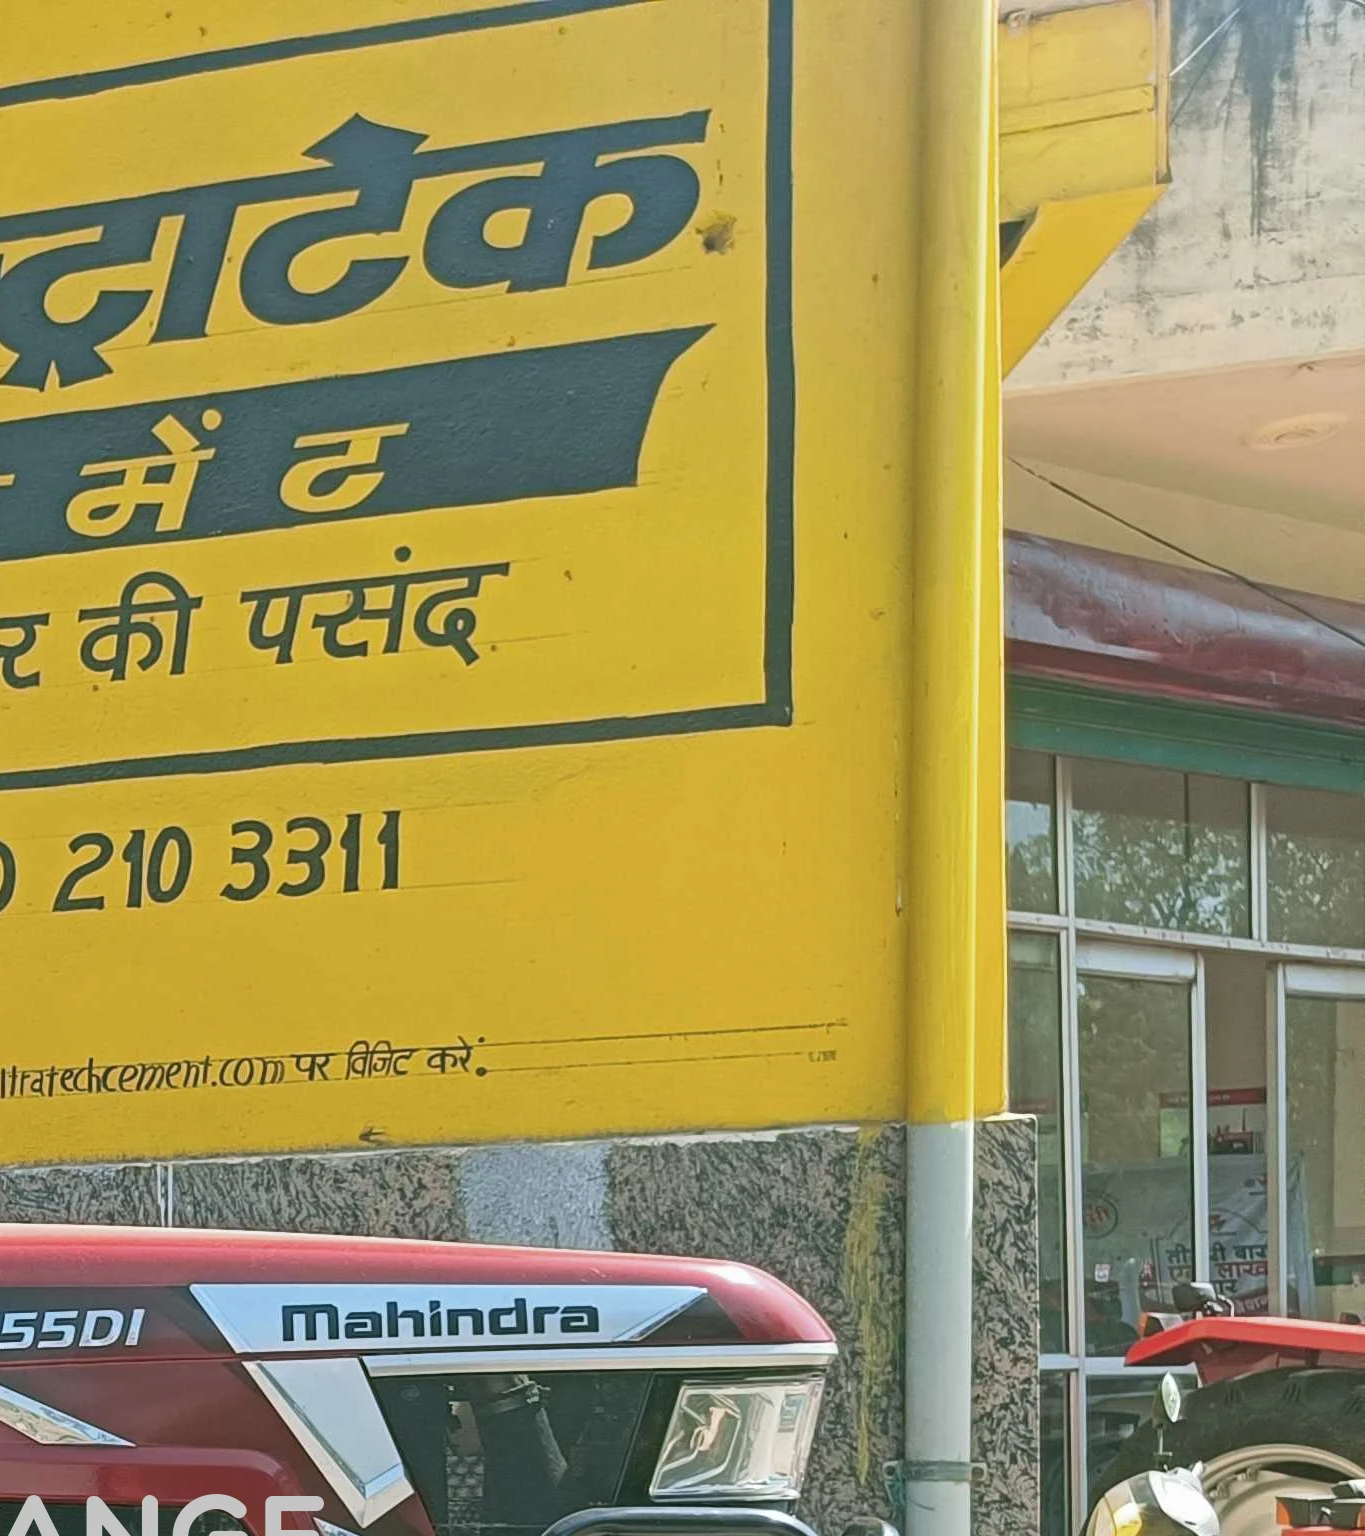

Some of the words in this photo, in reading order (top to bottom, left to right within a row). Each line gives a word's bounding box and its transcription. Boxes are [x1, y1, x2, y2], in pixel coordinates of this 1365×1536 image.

[66, 407, 223, 537] में
[280, 423, 411, 514] ट
[77, 571, 203, 682] की
[240, 546, 512, 667] पसंद
[51, 825, 193, 913] 210
[219, 810, 402, 902] 3311
[291, 1053, 337, 1083] पर
[343, 1039, 420, 1081] विजिट
[281, 1297, 600, 1342] Mahindra
